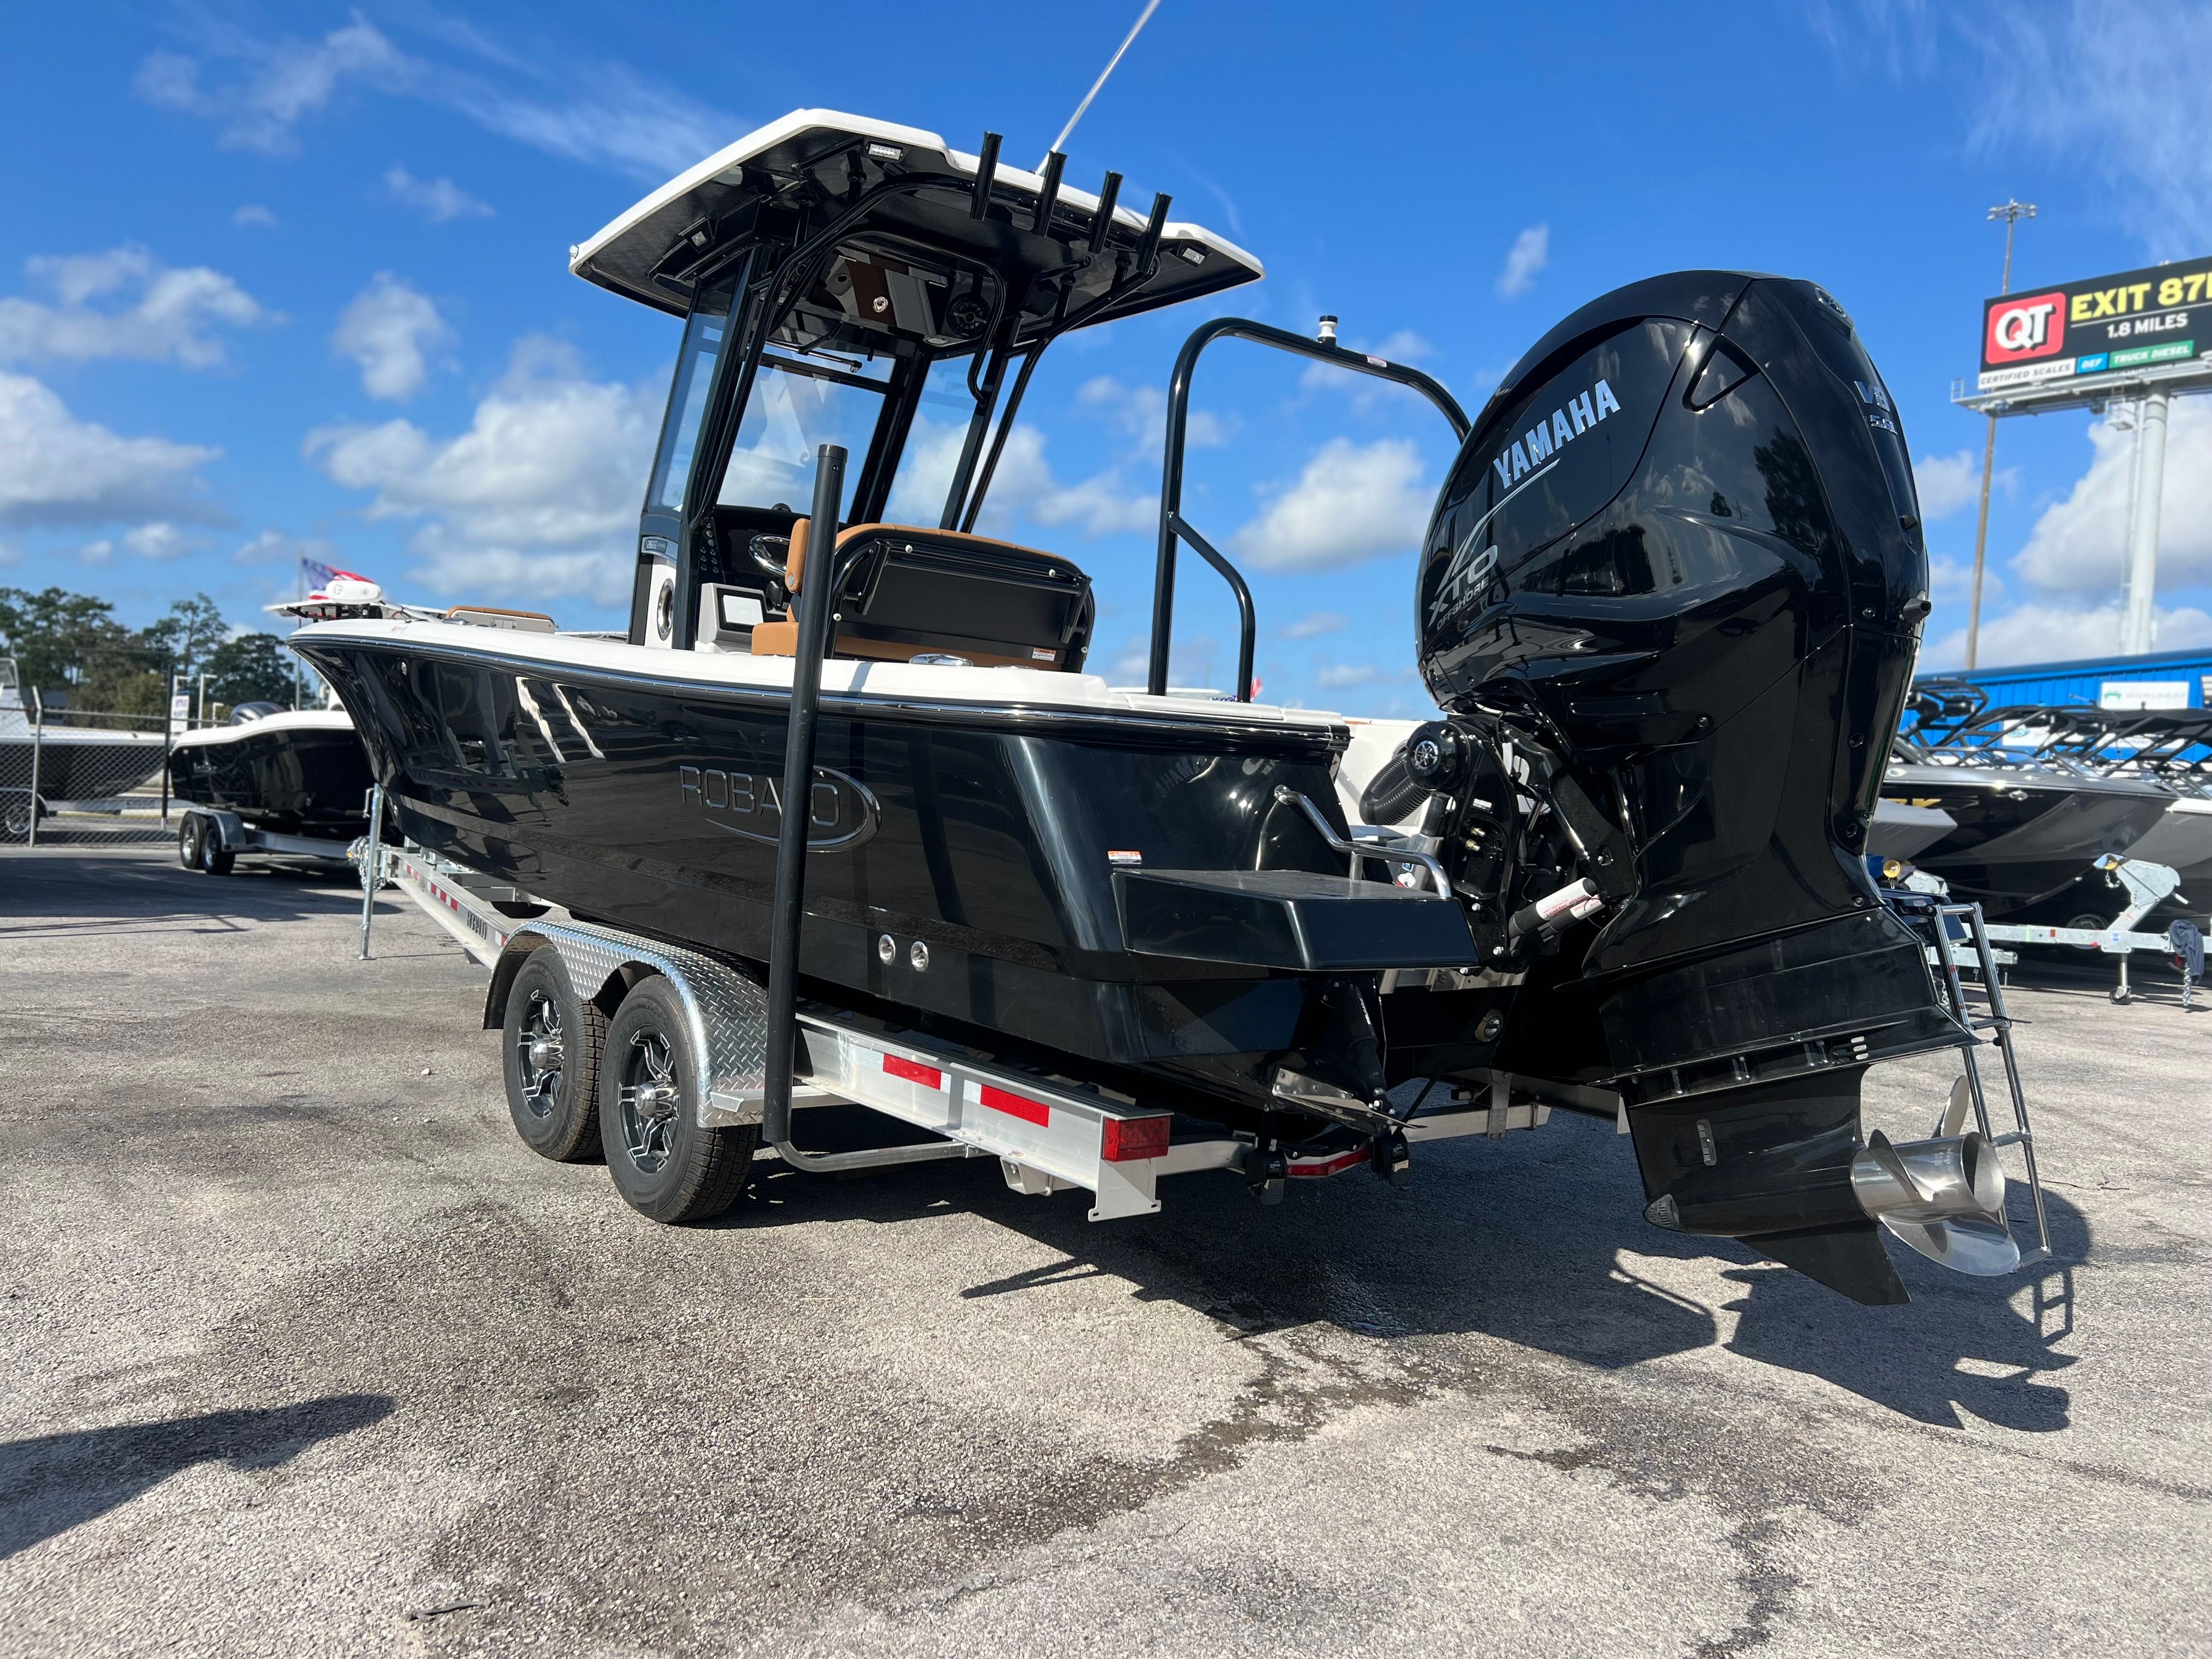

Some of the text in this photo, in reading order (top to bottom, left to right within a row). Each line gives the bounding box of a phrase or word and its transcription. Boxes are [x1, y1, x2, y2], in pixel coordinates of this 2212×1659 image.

[2070, 282, 2152, 321] EXIT
[1995, 303, 2053, 351] QT
[2107, 312, 2188, 338] 1.8 MILES
[1980, 363, 2070, 385] CERTIFIED SCALES
[2081, 357, 2103, 369] DEF
[2113, 345, 2190, 364] TRUCK DIESEL
[1492, 379, 1621, 490] YAMAHA
[1436, 575, 1490, 631] OFFSHORE
[680, 765, 840, 828] ROBAO
